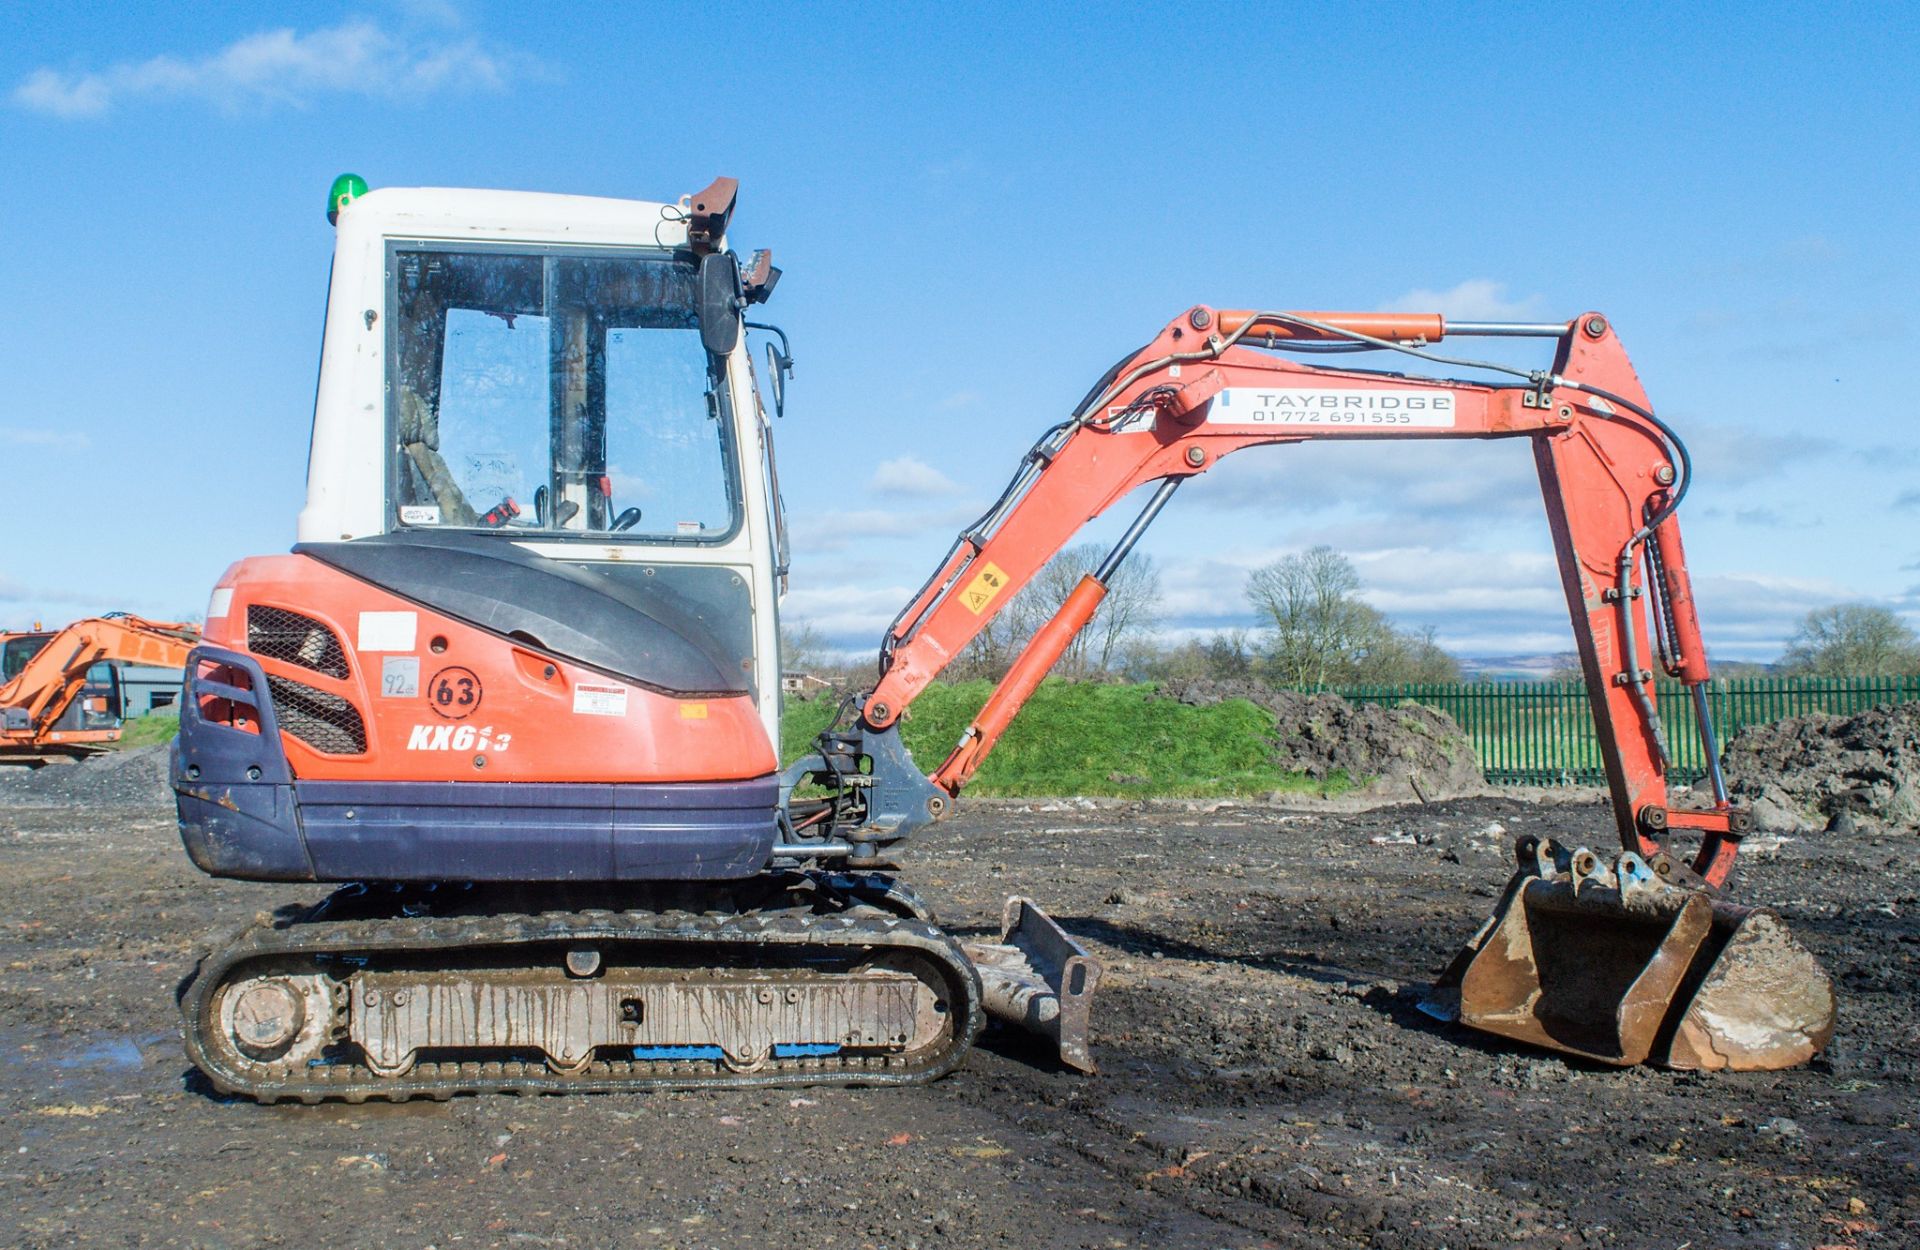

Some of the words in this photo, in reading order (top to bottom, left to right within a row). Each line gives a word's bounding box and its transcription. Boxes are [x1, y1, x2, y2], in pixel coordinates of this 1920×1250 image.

[1256, 394, 1451, 410] TAYBRIDGE
[1252, 410, 1320, 423] 01772
[1329, 411, 1411, 424] 691555
[385, 674, 405, 694] 92
[436, 677, 475, 706] 63
